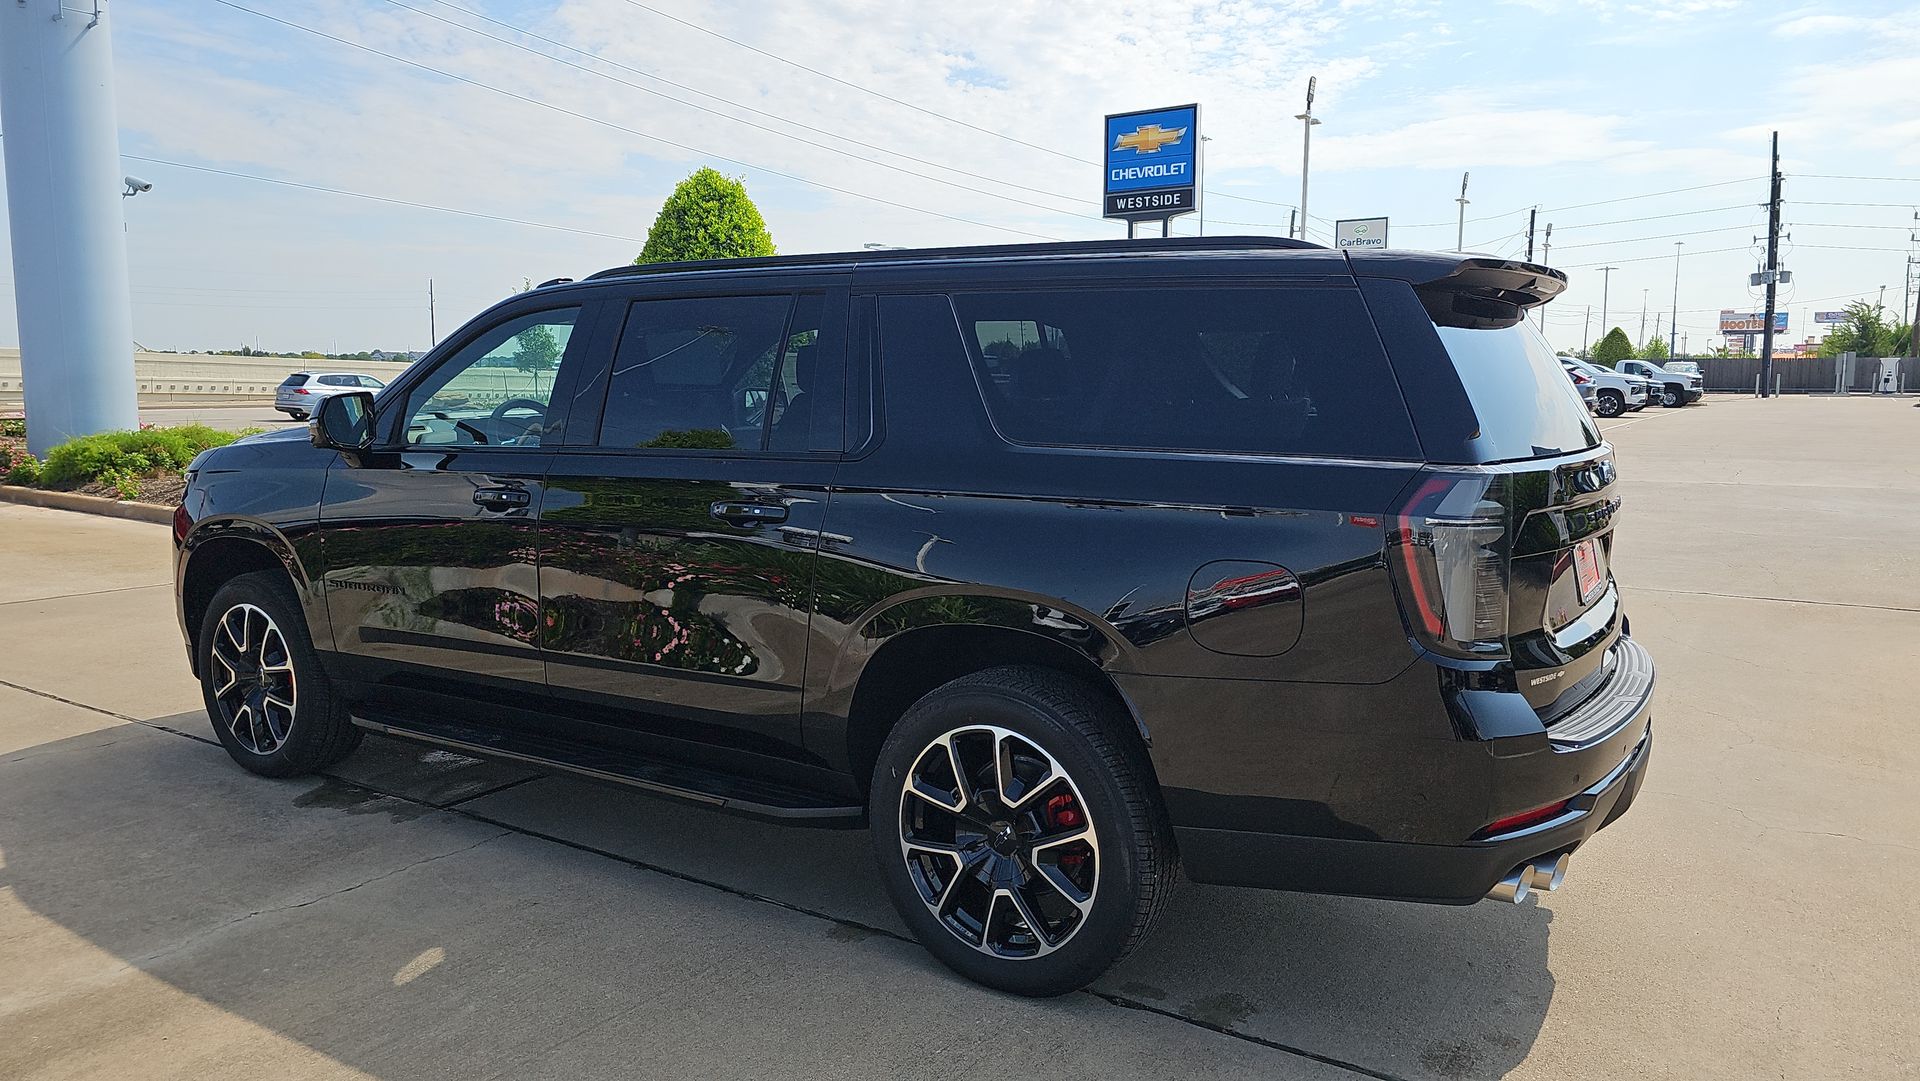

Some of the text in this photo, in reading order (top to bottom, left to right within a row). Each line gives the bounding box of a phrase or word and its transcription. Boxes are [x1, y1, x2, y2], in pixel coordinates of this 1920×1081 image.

[1111, 162, 1187, 181] CHEVROLET
[1116, 193, 1181, 210] WESTSIDE
[1340, 237, 1382, 247] CarBravo
[1720, 320, 1764, 330] HOOTER
[1530, 672, 1558, 687] WESTSIDE
